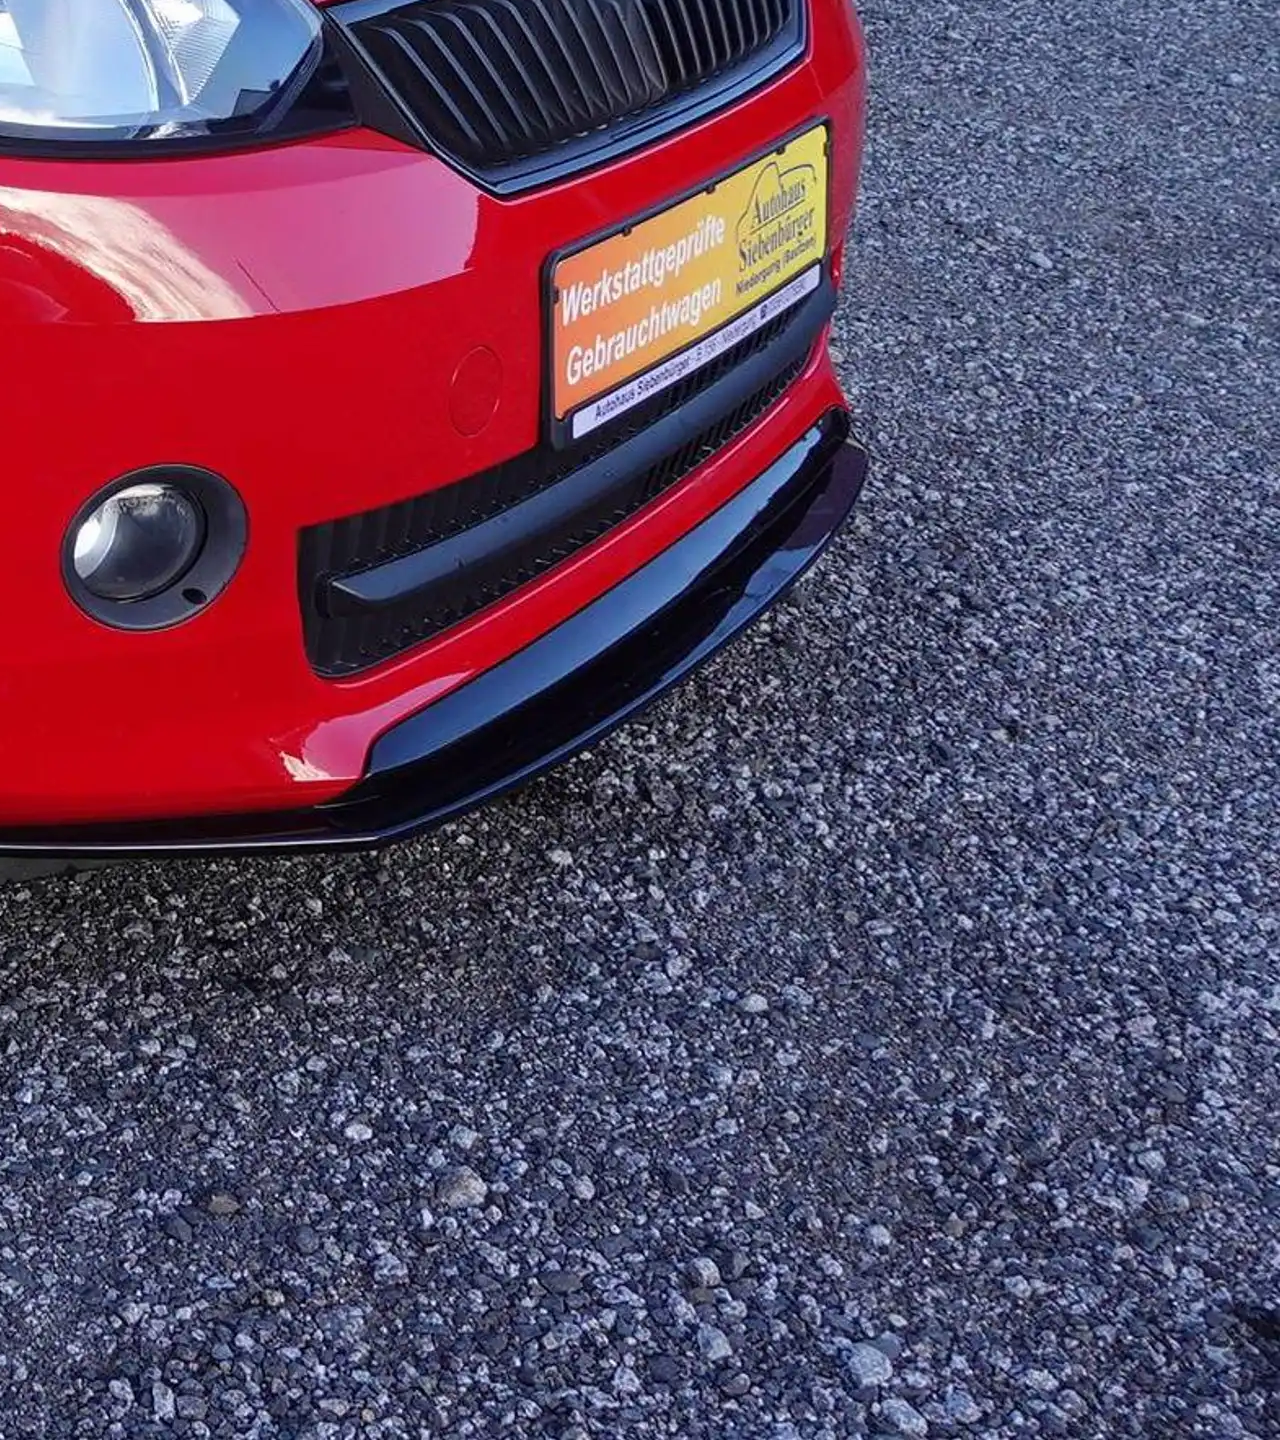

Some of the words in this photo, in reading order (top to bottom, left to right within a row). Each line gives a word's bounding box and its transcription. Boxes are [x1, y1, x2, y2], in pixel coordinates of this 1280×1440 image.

[738, 207, 816, 272] Siebenbürger
[751, 180, 807, 227] Autohaus
[561, 214, 726, 327] Werkstattgeprüfte
[566, 276, 722, 386] Gebrauchtwagen
